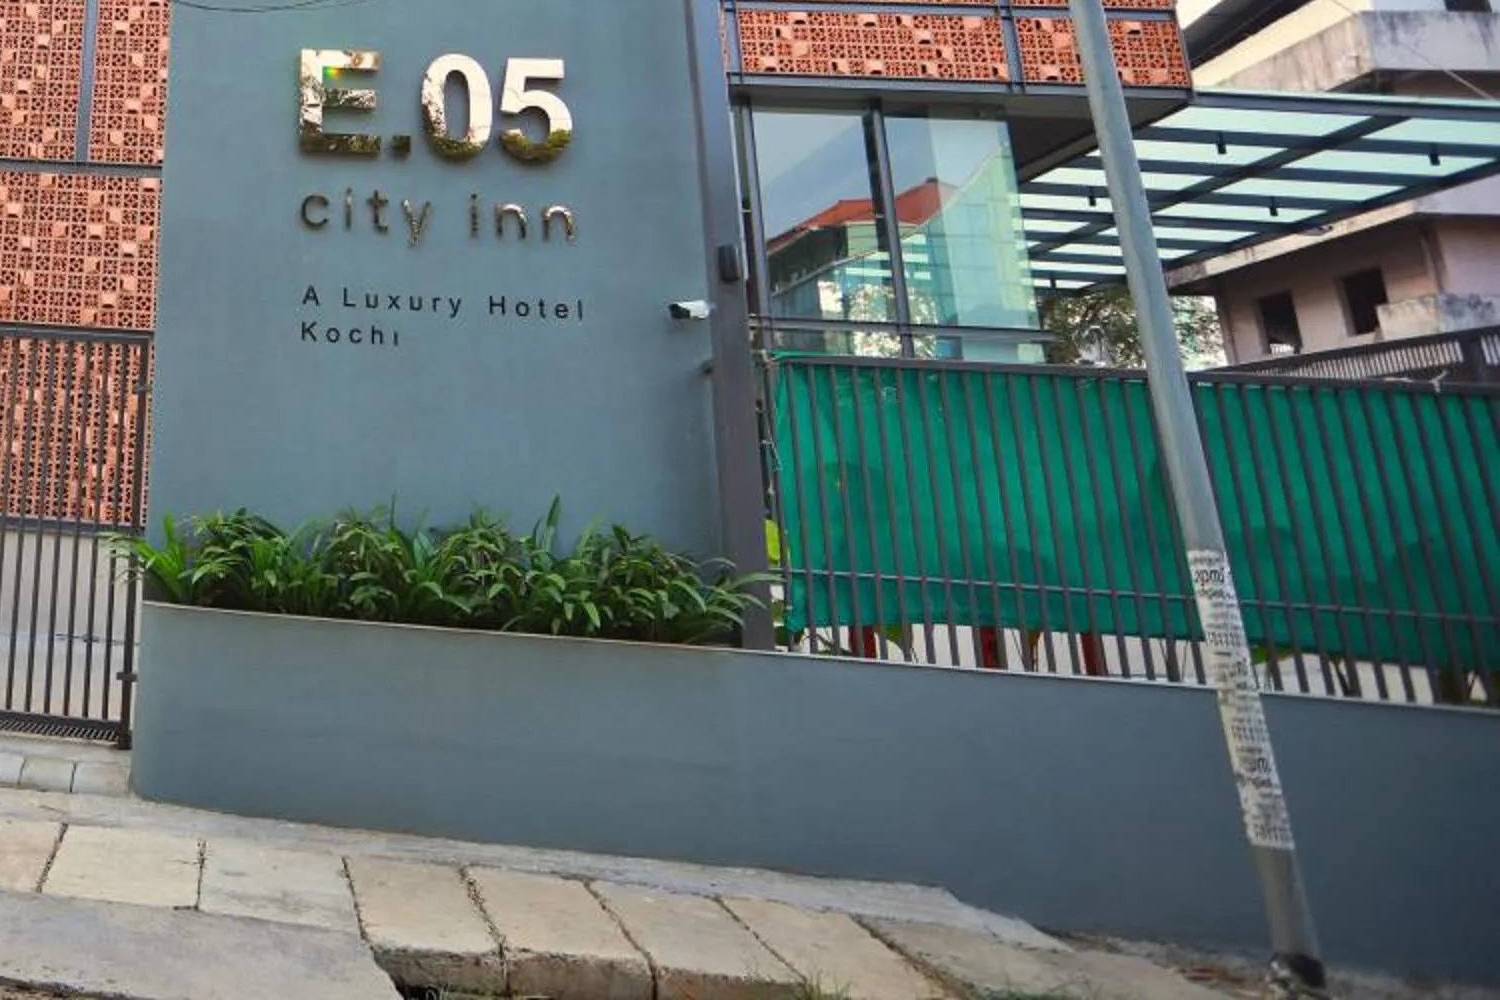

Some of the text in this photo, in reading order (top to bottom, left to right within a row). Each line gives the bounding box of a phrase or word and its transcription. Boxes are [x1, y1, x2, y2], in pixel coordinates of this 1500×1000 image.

[298, 48, 573, 164] E.05
[300, 187, 577, 248] city inn
[302, 285, 585, 321] A Luxury Hotel
[301, 322, 400, 347] Kochi
